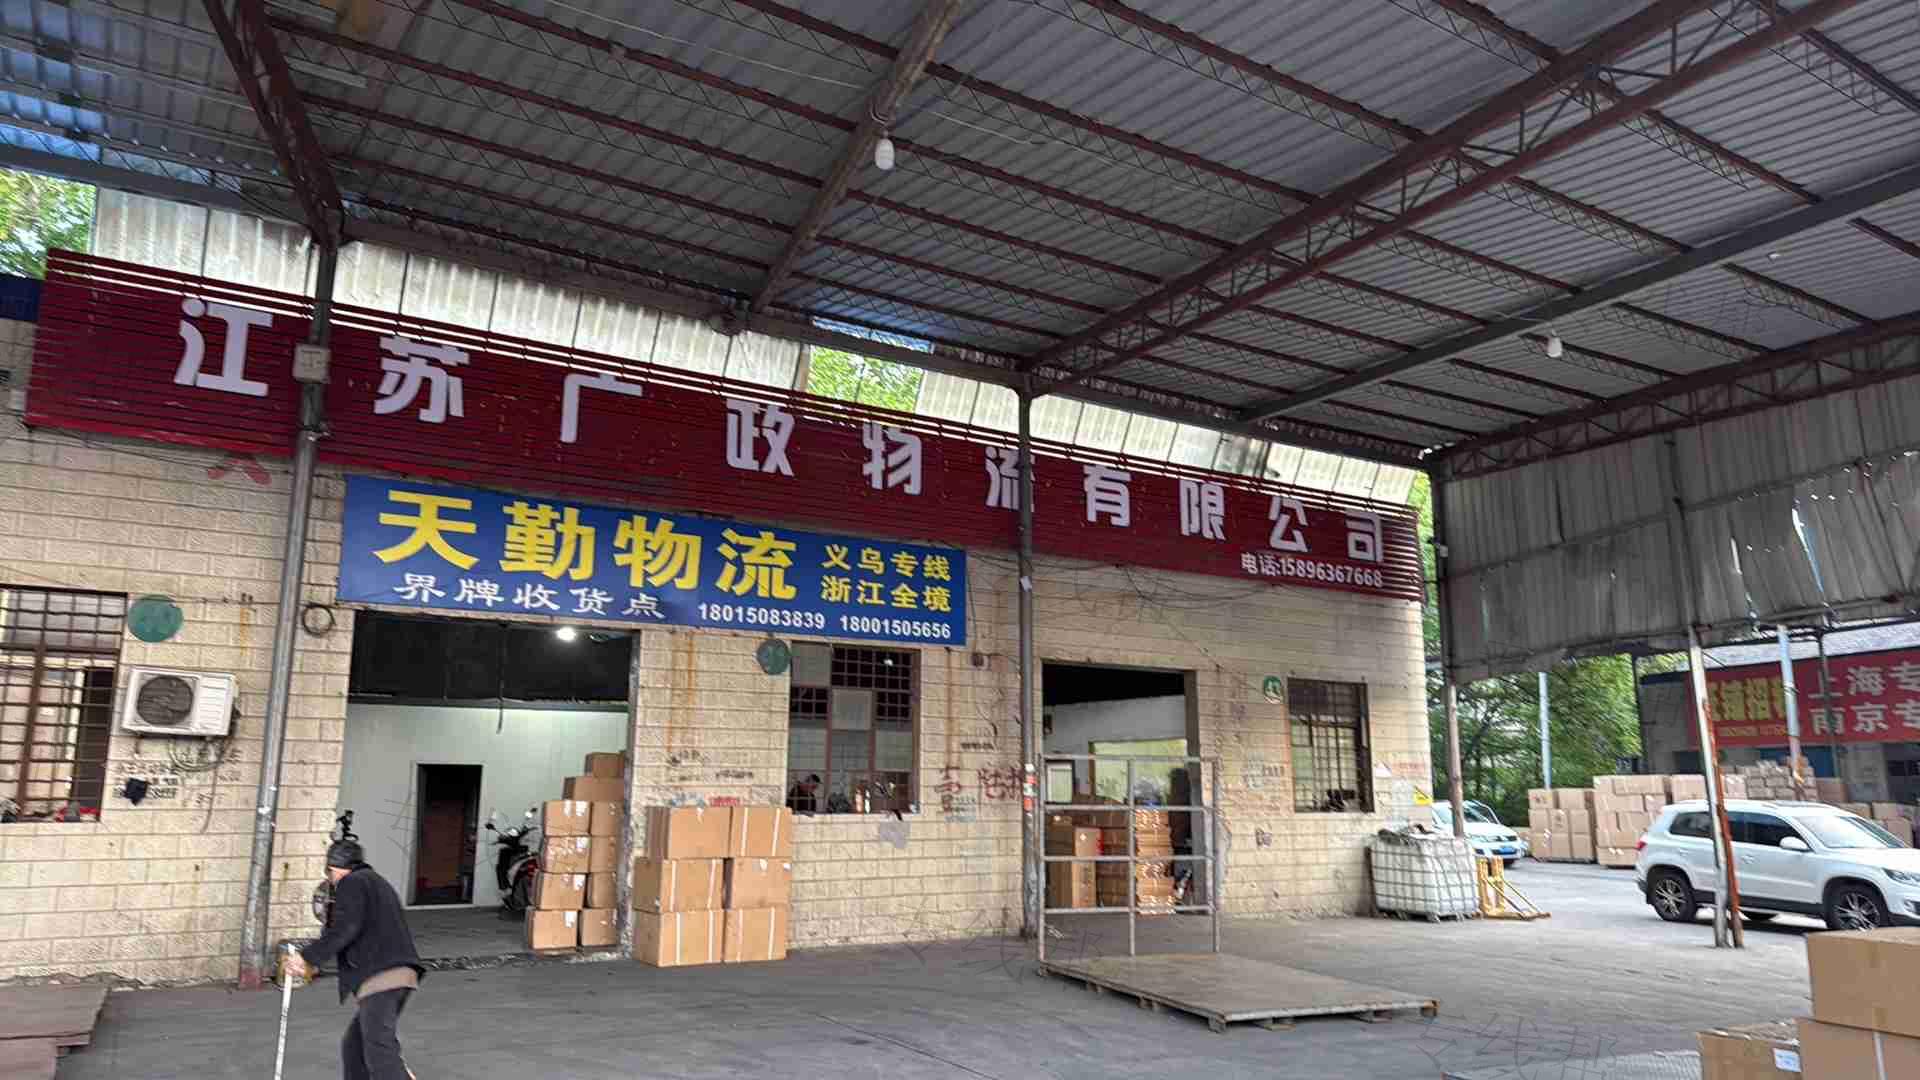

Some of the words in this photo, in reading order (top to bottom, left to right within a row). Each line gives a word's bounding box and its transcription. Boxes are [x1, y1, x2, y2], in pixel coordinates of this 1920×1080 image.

[173, 298, 1384, 562] 江苏广政物流有限公司
[373, 489, 797, 600] 天勤物流
[820, 543, 952, 582] 义乌专线
[1240, 552, 1384, 588] 电话:15896367668
[392, 573, 666, 619] 界牌收货点
[820, 575, 952, 612] 浙江全境
[698, 603, 826, 630] 18015083839
[839, 615, 952, 639] 18001505656
